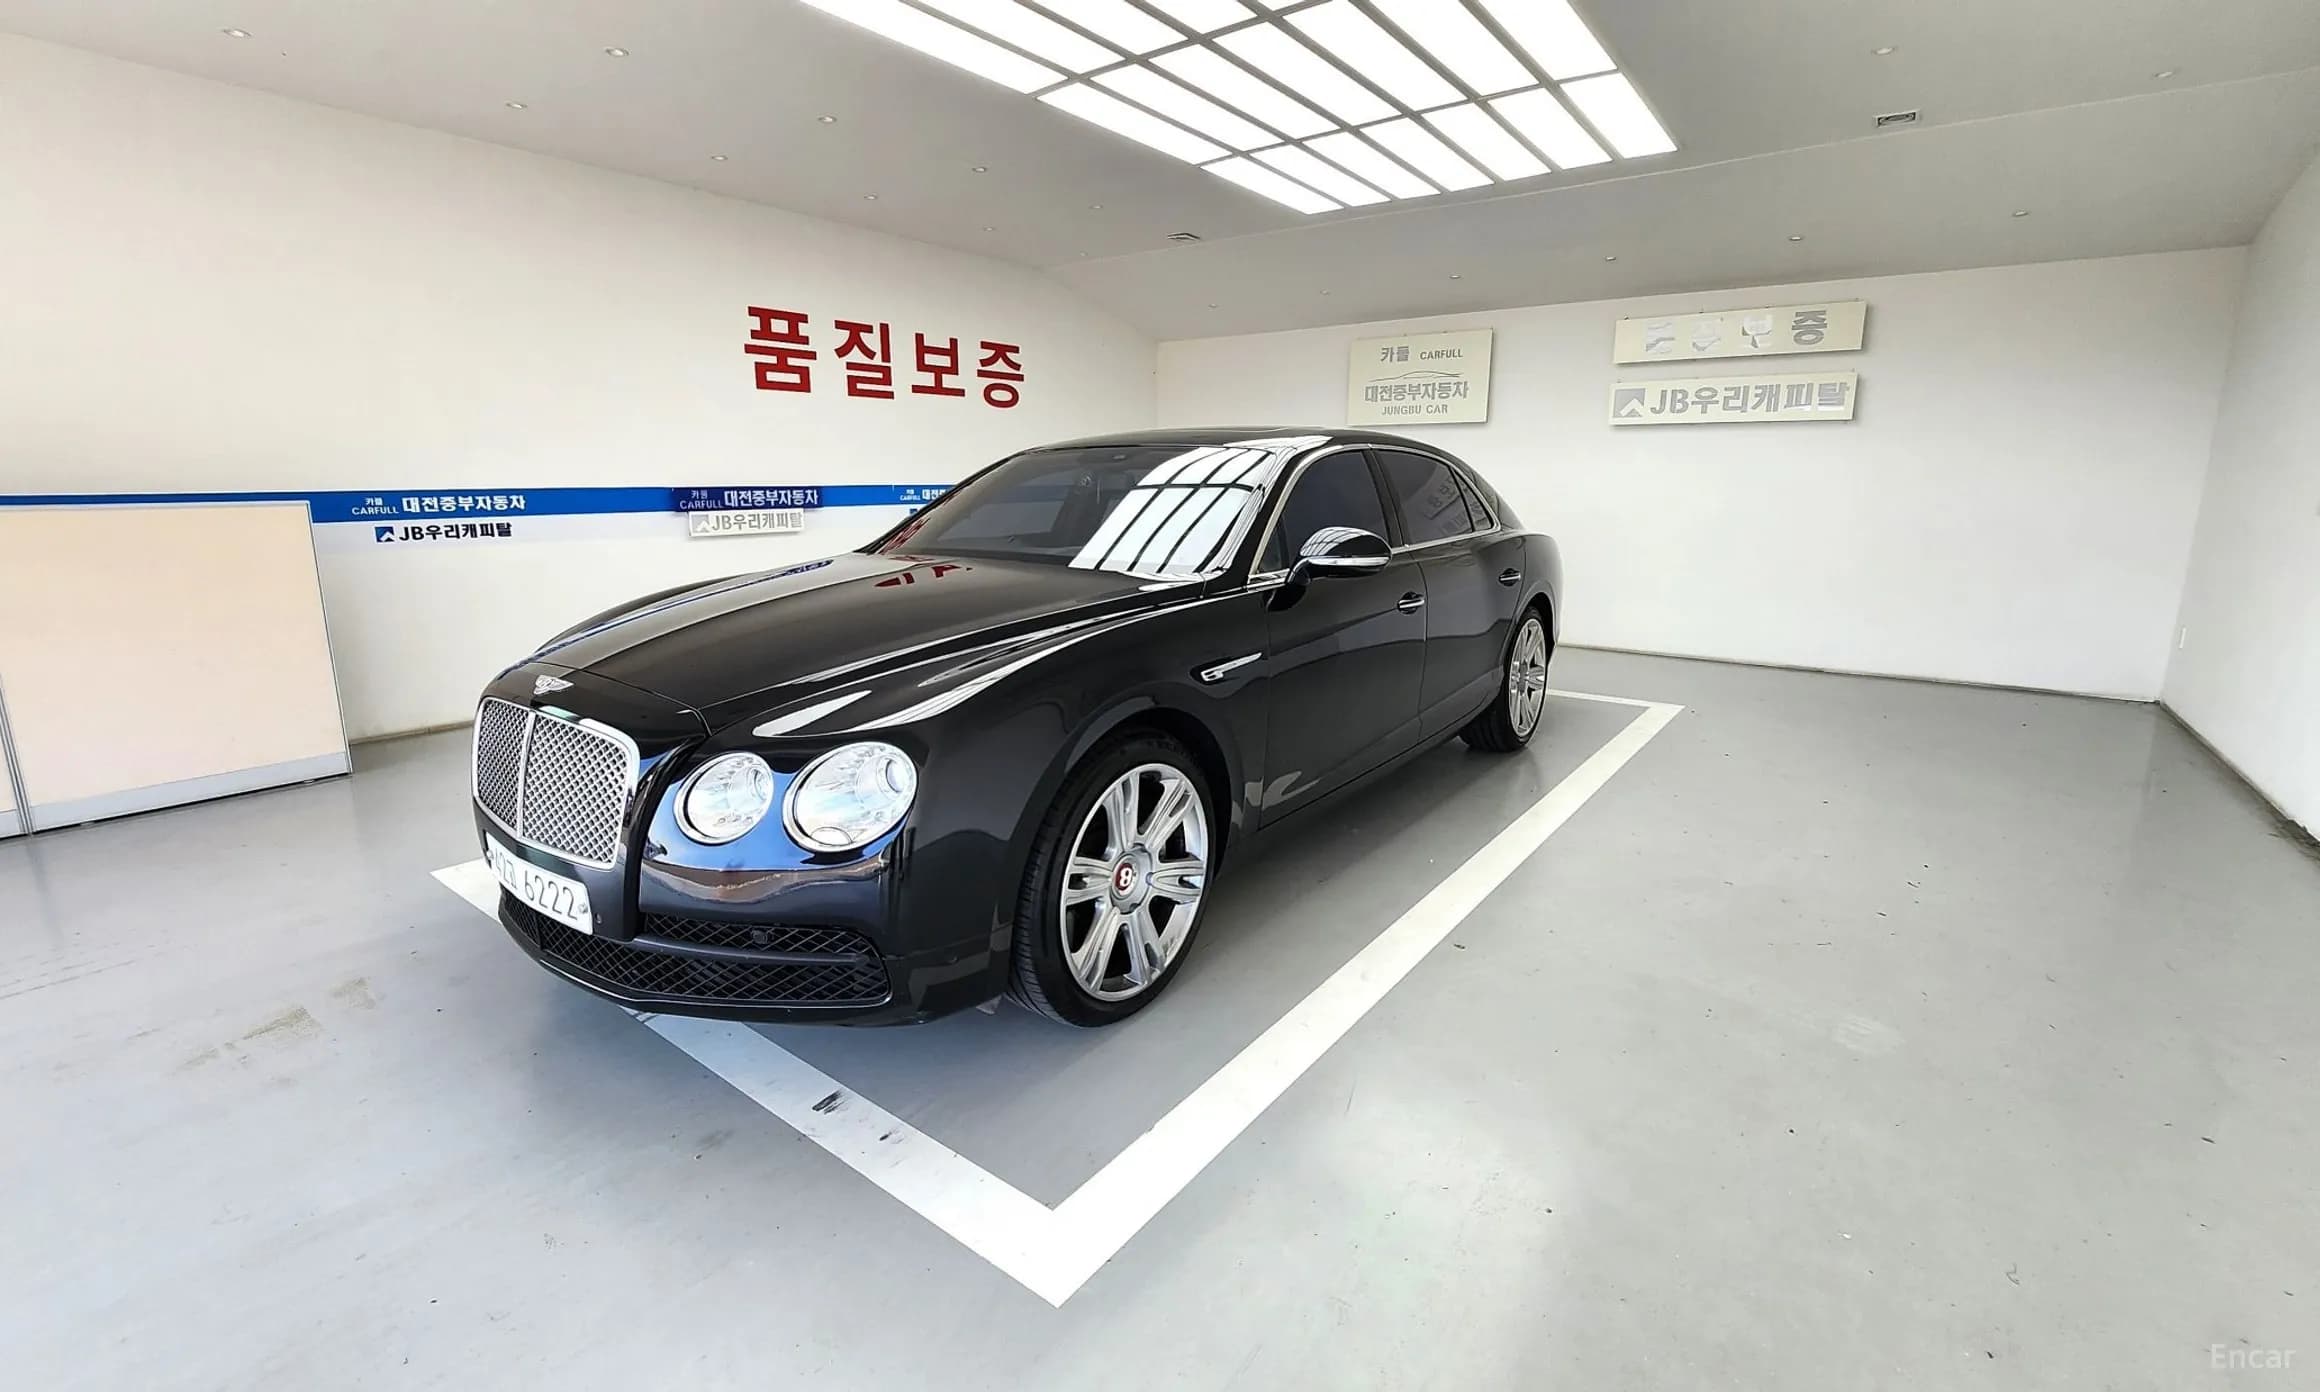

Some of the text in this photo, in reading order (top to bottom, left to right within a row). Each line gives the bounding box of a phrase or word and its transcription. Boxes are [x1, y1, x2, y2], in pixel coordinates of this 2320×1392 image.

[744, 306, 1024, 409] 품질보증
[1420, 349, 1463, 360] CARFULL
[1364, 381, 1469, 402] 대전중부자동차
[1650, 382, 1850, 415] JB우리캐피탈
[1382, 404, 1448, 415] JUNGBU CAR
[402, 495, 526, 513] 대전중부자동차
[680, 500, 723, 509] CARFULL
[724, 489, 818, 508] 대전중부자동차
[351, 506, 399, 516] CARFULL
[712, 511, 803, 531] JB우리캐피탈
[398, 522, 512, 542] JB우리캐피탈
[524, 870, 578, 920] 6222
